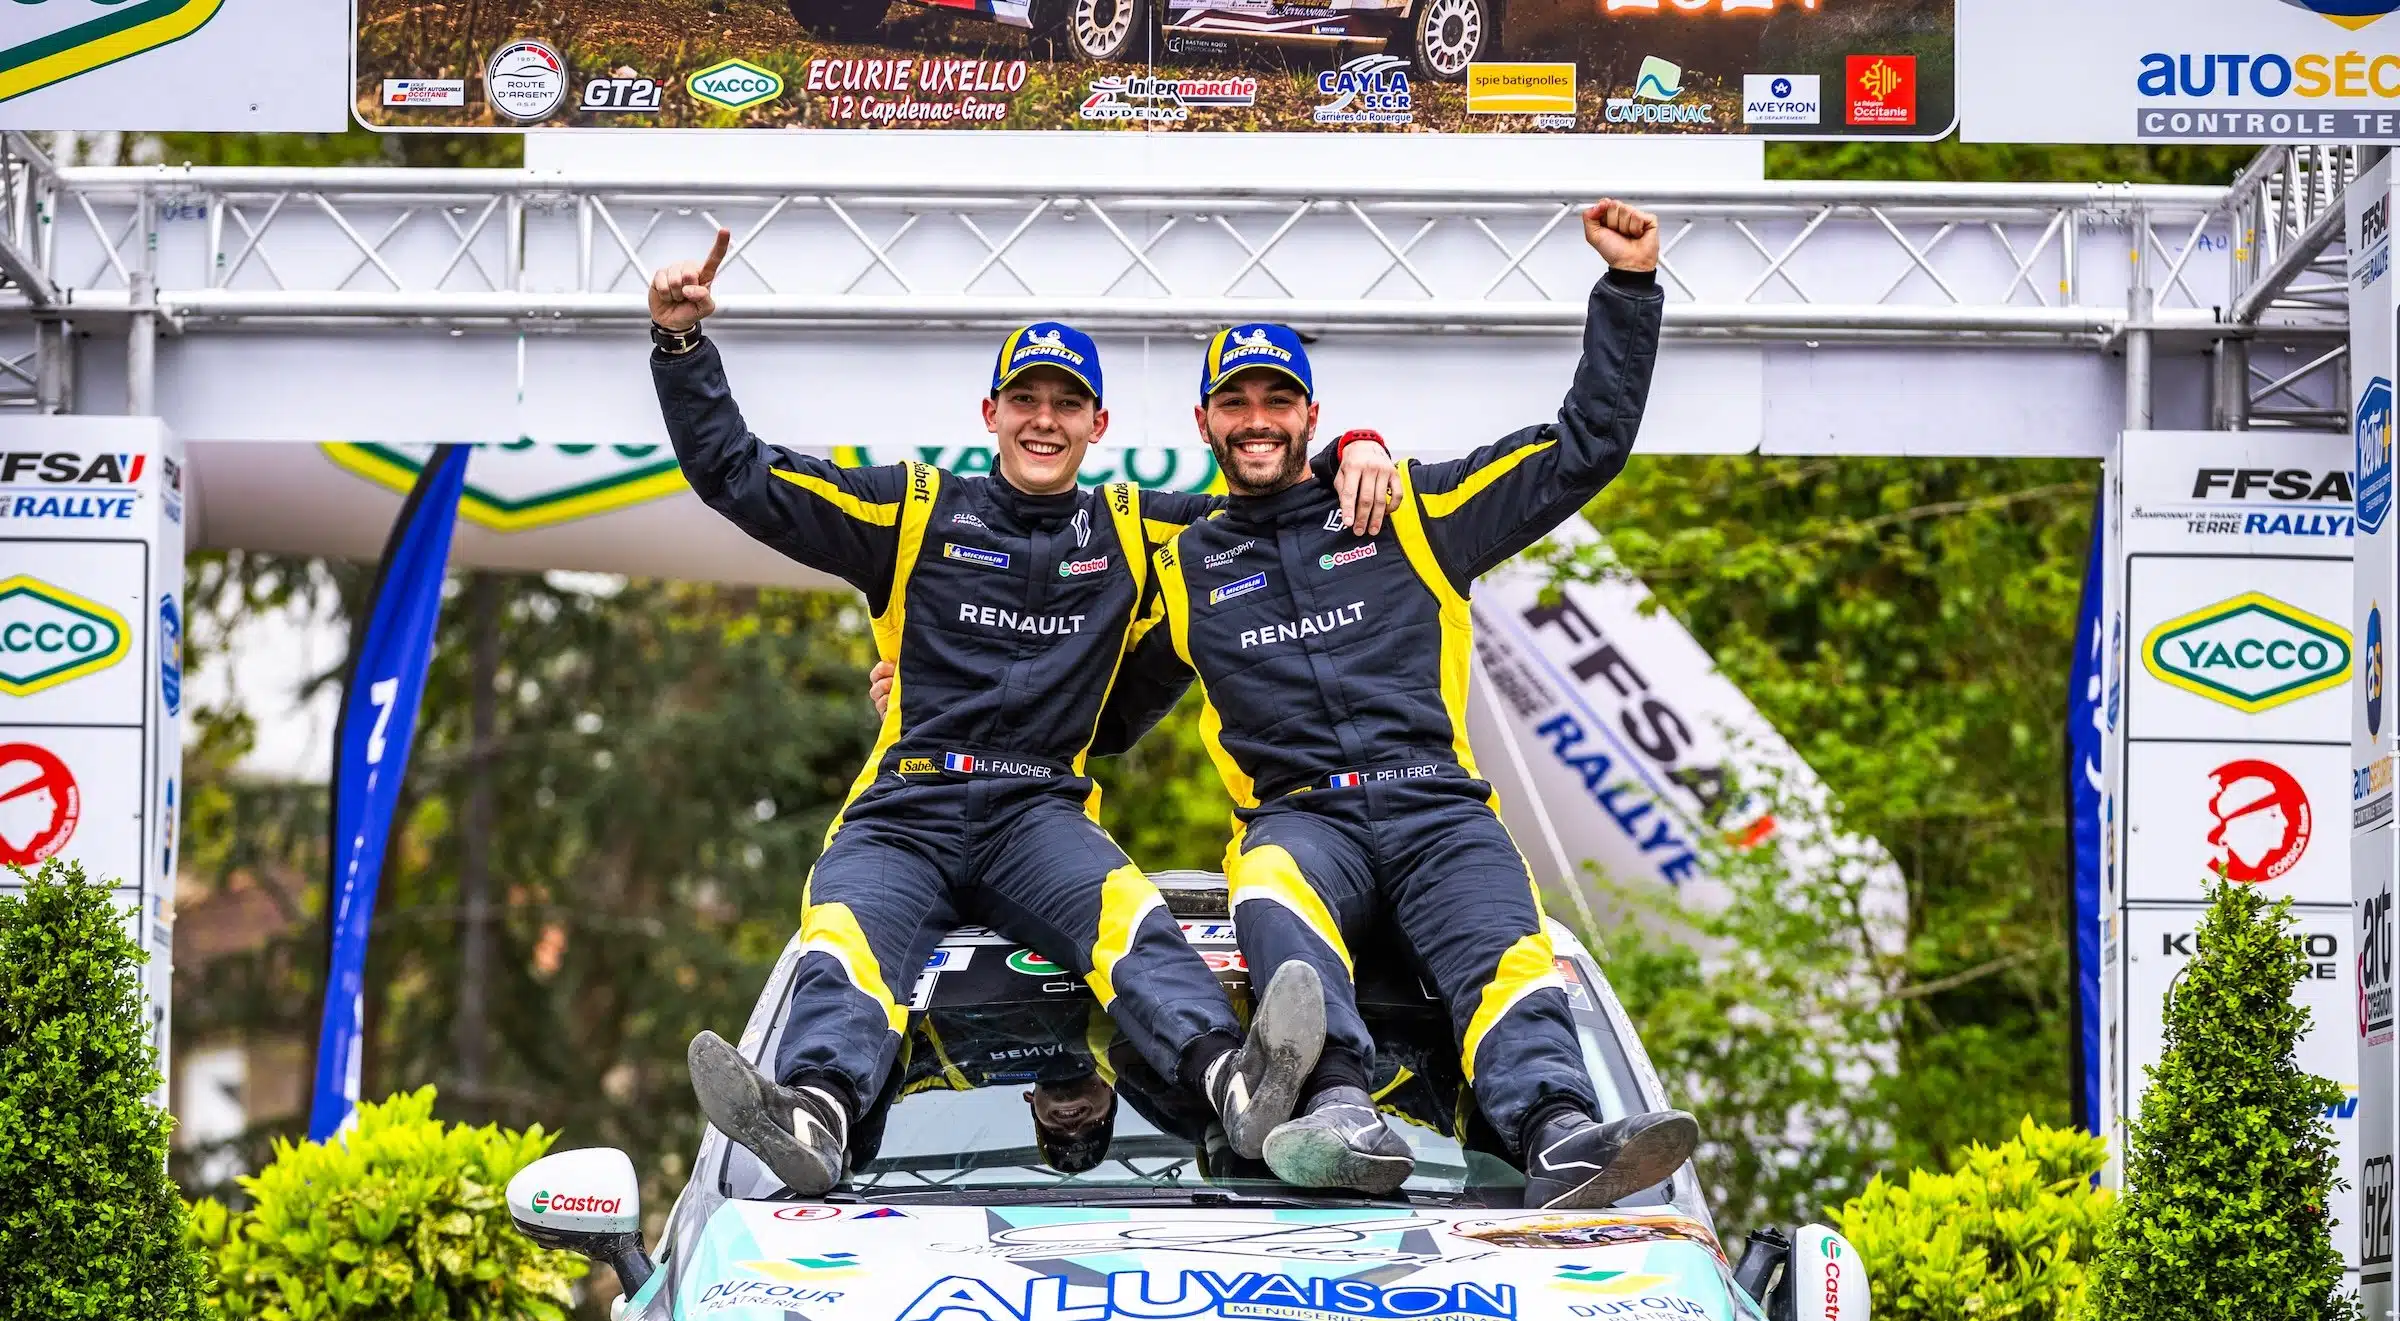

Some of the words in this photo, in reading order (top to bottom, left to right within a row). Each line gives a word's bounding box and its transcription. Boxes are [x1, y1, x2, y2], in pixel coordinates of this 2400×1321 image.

[807, 59, 913, 91] ECURIE
[920, 59, 1027, 92] UXELLO
[1319, 73, 1408, 92] CAYLA
[1476, 75, 1500, 87] spie
[1503, 75, 1568, 87] batignolles
[702, 79, 769, 93] YACCO
[831, 96, 852, 118] 12
[860, 96, 1006, 124] Capdenac-Gare
[1083, 109, 1186, 118] CAPDENAC
[1315, 112, 1353, 121] Carrières
[1355, 112, 1367, 121] du
[1369, 112, 1411, 123] Rouergue
[1606, 104, 1712, 123] CAPDENAC
[1748, 102, 1816, 113] AVEYRON
[1853, 107, 1908, 117] Occitanie
[2145, 112, 2335, 134] CONTROLE
[2361, 193, 2387, 250] FFSA
[1012, 346, 1084, 366] MICHELIN
[1222, 345, 1292, 365] MICHELIN
[0, 453, 122, 483] FSA
[2192, 468, 2353, 501] FFSA
[13, 497, 135, 518] RALLYE
[2131, 511, 2193, 520] CHAMPIONNAT
[2209, 512, 2244, 520] FRANCE
[2188, 521, 2241, 534] TERRE
[962, 551, 1004, 564] MICHELIN
[1210, 558, 1233, 568] FRANCE
[1334, 544, 1376, 563] Castrol
[1071, 558, 1107, 573] Castrol
[1225, 578, 1262, 596] MICHELIN
[959, 603, 1085, 635] RENAULT
[1240, 601, 1366, 650] RENAULT
[0, 622, 97, 653] CCO
[2178, 639, 2329, 670] YACCO
[975, 760, 989, 772] H.
[992, 761, 1051, 778] FAUCHER
[1536, 711, 1701, 887] RALLYE
[2266, 836, 2307, 878] CORSICA
[551, 1193, 621, 1215] Castrol
[700, 1280, 845, 1303] DUFOUR
[1568, 1296, 1712, 1321] DUFOUR
